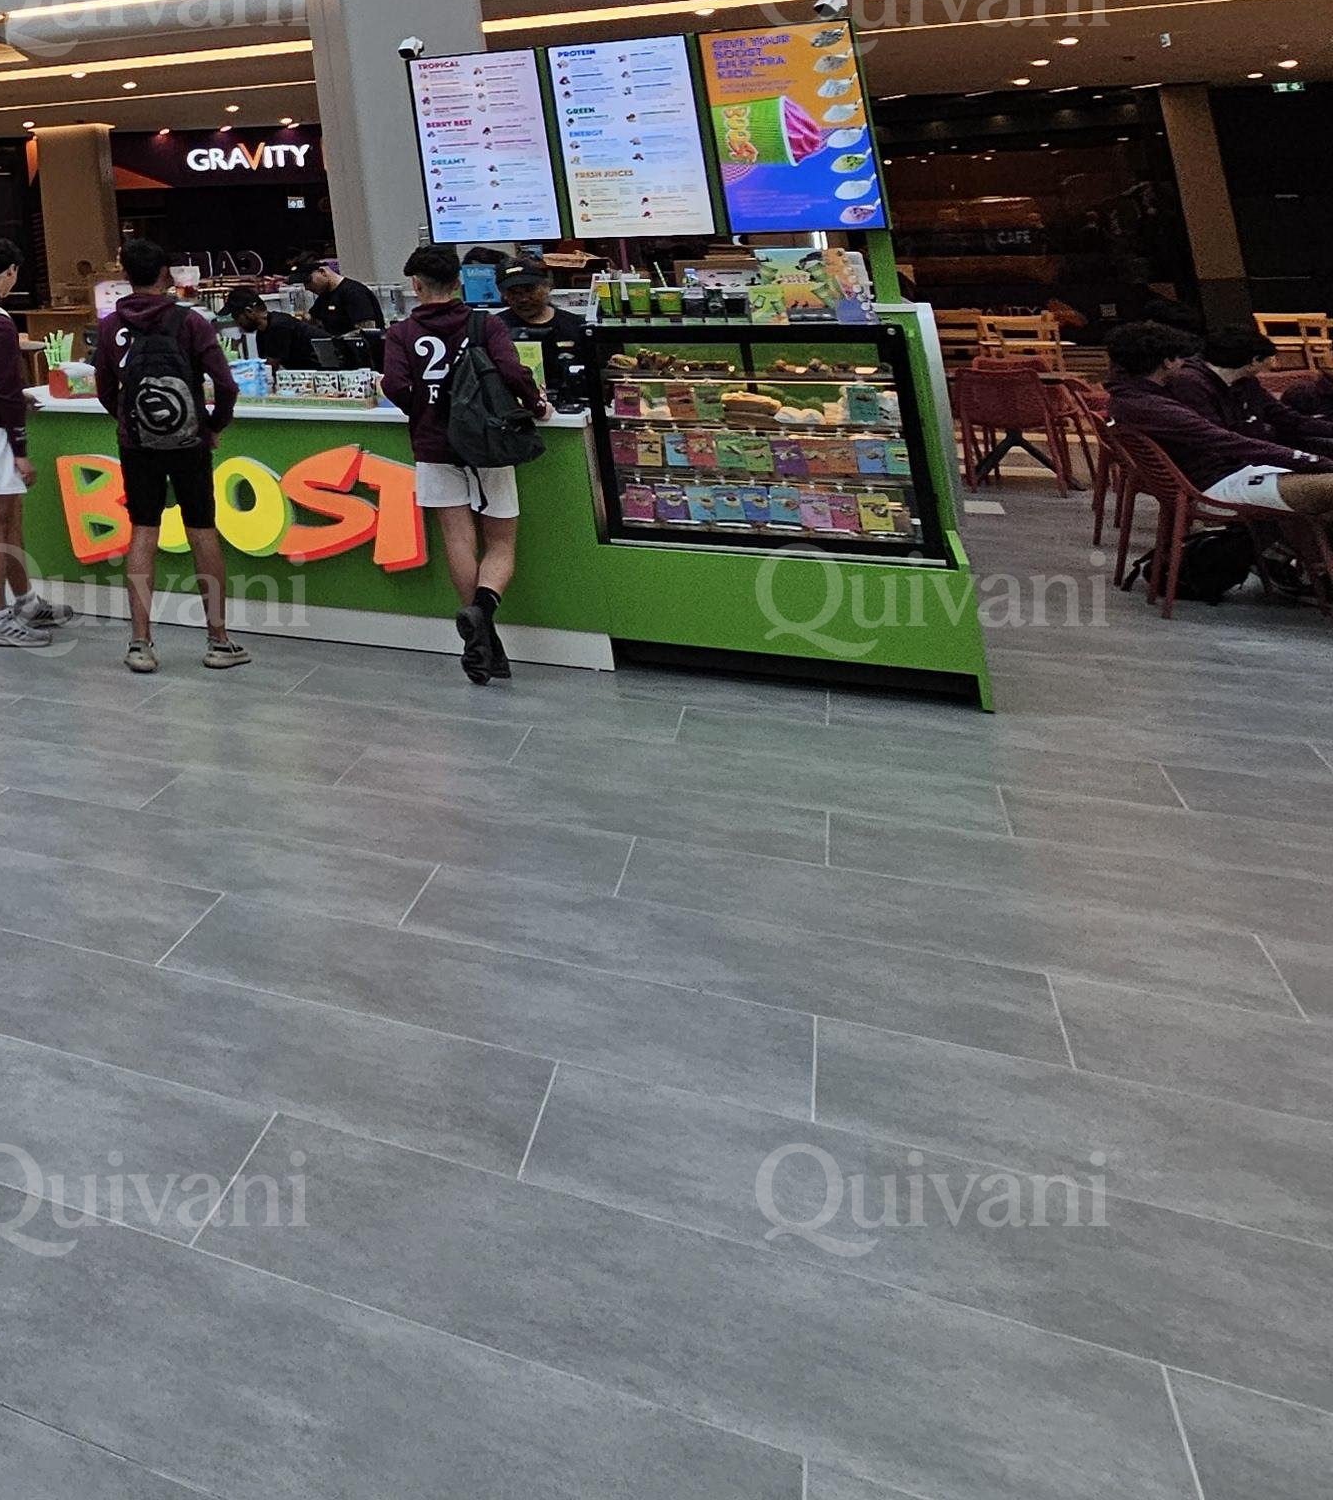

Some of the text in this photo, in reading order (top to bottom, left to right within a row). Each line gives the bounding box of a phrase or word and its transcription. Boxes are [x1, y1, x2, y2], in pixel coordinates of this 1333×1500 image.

[557, 49, 596, 58] PROTEIN
[418, 61, 460, 70] TROPICAL
[566, 107, 595, 115] GREEN
[187, 141, 310, 172] GRAVITY
[431, 158, 466, 166] DREAMY
